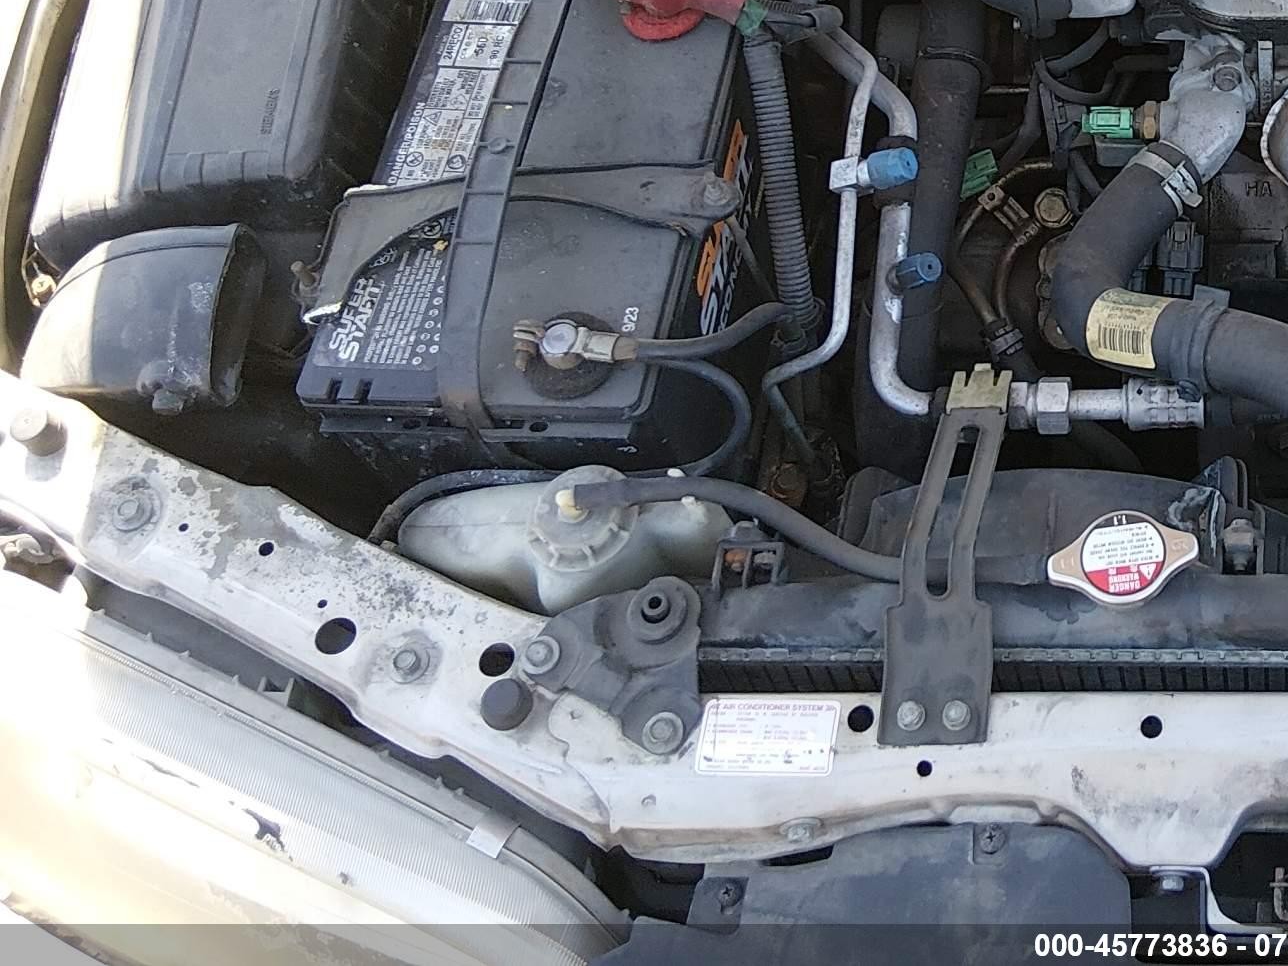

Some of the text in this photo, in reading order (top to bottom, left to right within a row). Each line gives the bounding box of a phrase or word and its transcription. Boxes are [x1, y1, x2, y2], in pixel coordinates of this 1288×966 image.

[388, 103, 426, 183] DANGER/POISON
[329, 277, 367, 350] SUPER
[338, 277, 380, 362] START
[621, 306, 640, 332] 9/23
[1108, 574, 1140, 583] WARNING
[1109, 582, 1141, 593] DANGER
[738, 703, 790, 711] CONDITIONER
